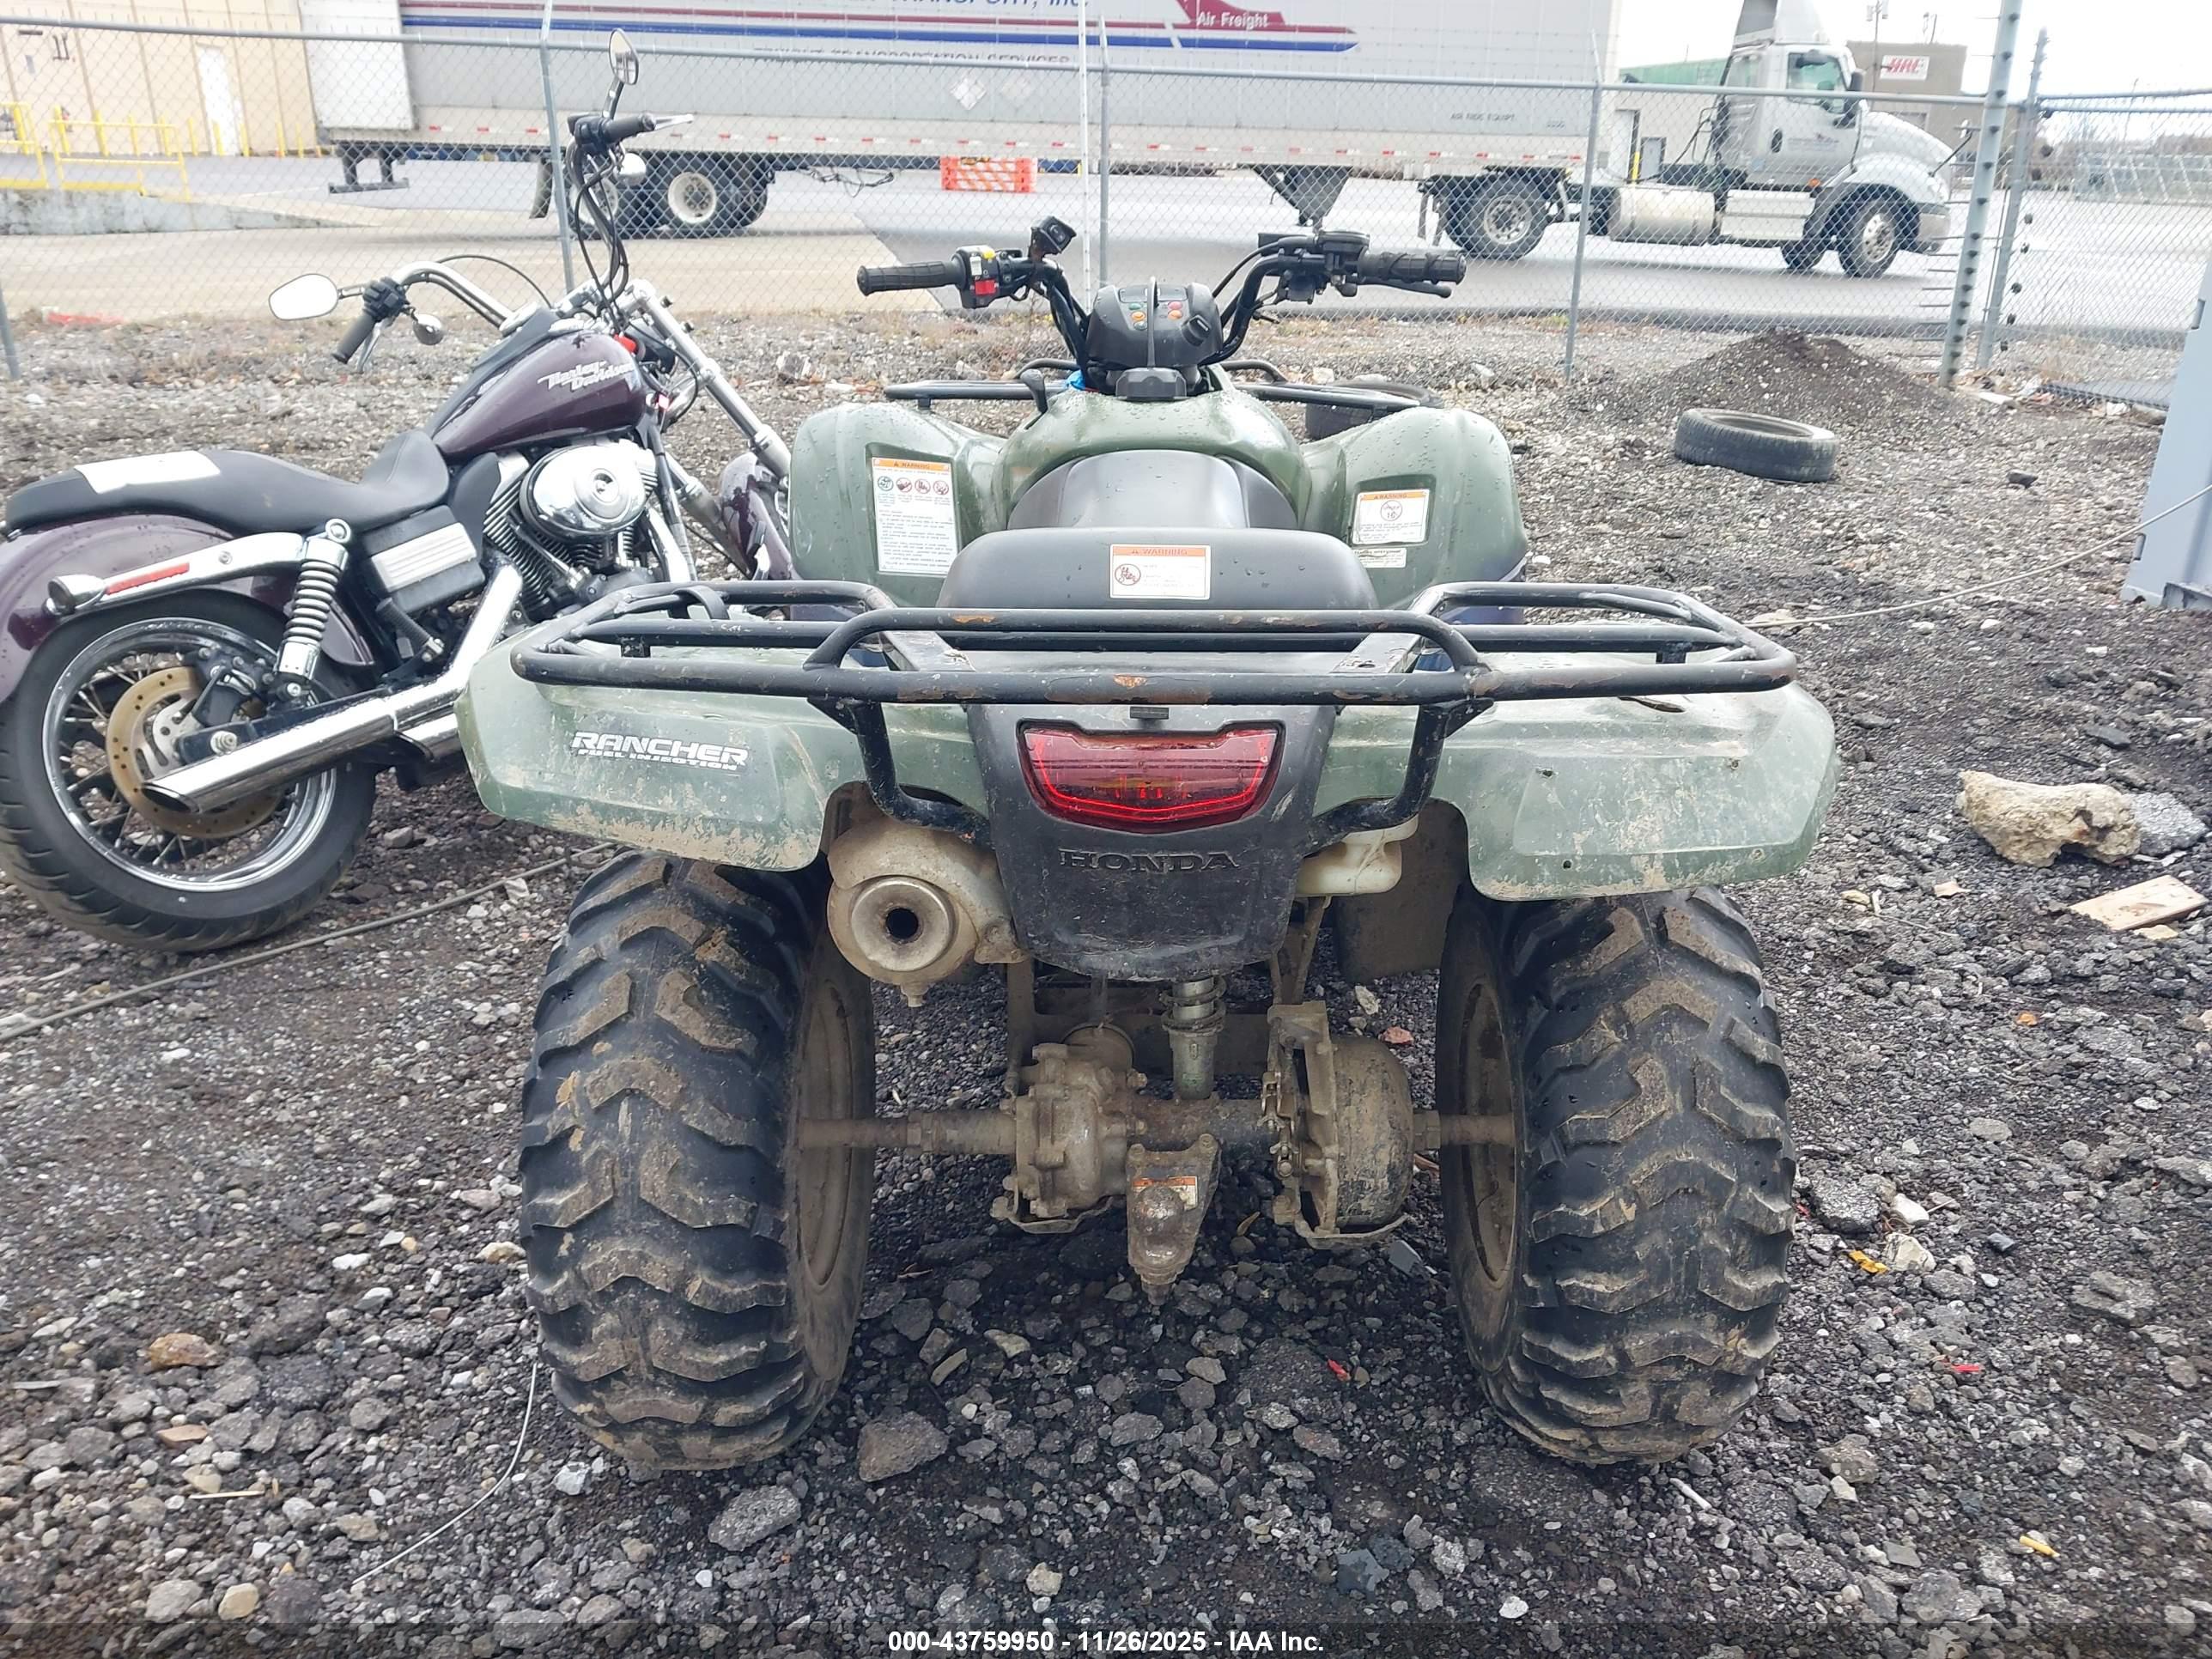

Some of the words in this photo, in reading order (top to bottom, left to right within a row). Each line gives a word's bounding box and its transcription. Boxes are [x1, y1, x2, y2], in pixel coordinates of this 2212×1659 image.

[1196, 11, 1216, 27] Air
[1221, 11, 1269, 29] Freight
[571, 732, 749, 766] RANCHER
[629, 753, 738, 770] INJECTION
[1058, 848, 1240, 872] HONDA
